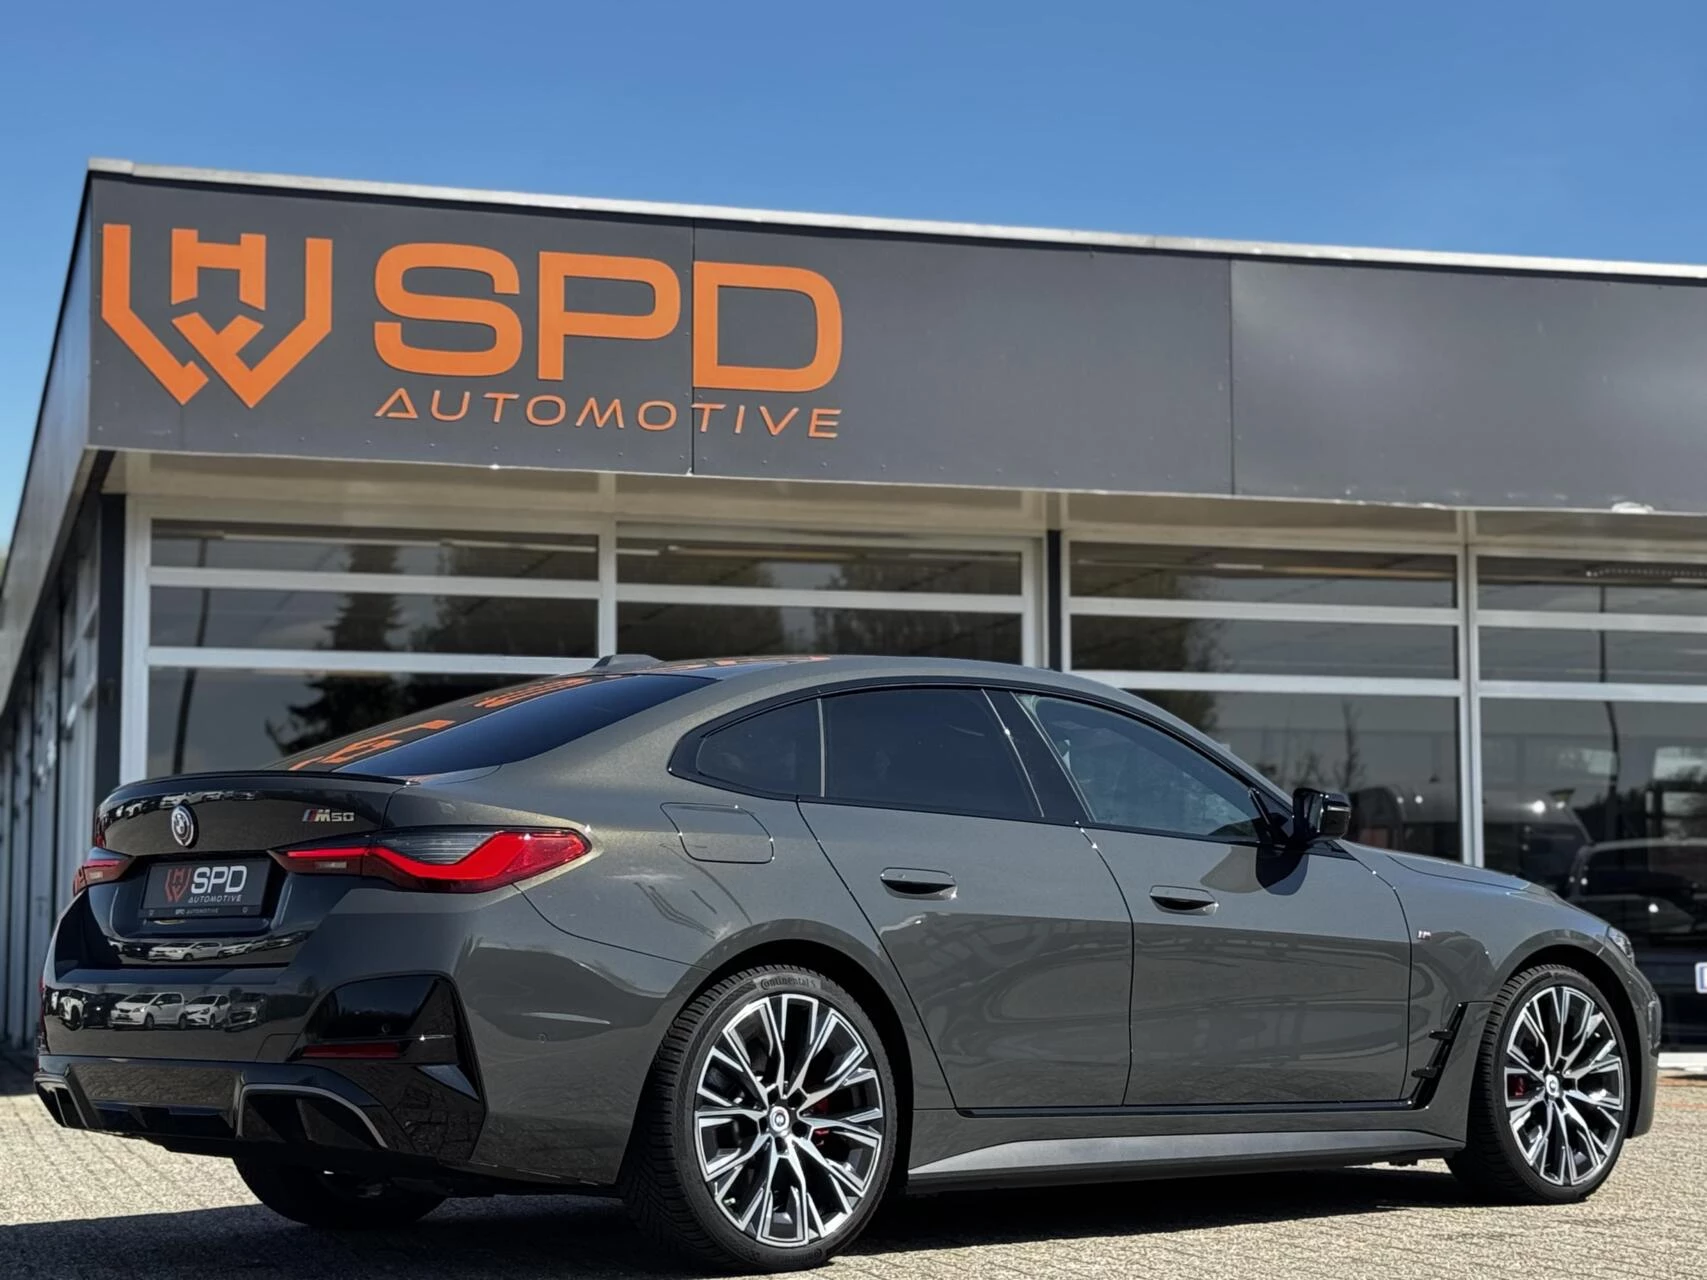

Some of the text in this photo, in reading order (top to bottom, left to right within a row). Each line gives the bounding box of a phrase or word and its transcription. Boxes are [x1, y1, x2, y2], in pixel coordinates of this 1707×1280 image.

[374, 243, 842, 392] SPD
[375, 388, 842, 438] AUTOMOTIVE
[313, 808, 355, 822] M50
[191, 865, 248, 894] SPD
[187, 894, 242, 904] AUTOMOTIVE
[760, 976, 809, 991] Continental
